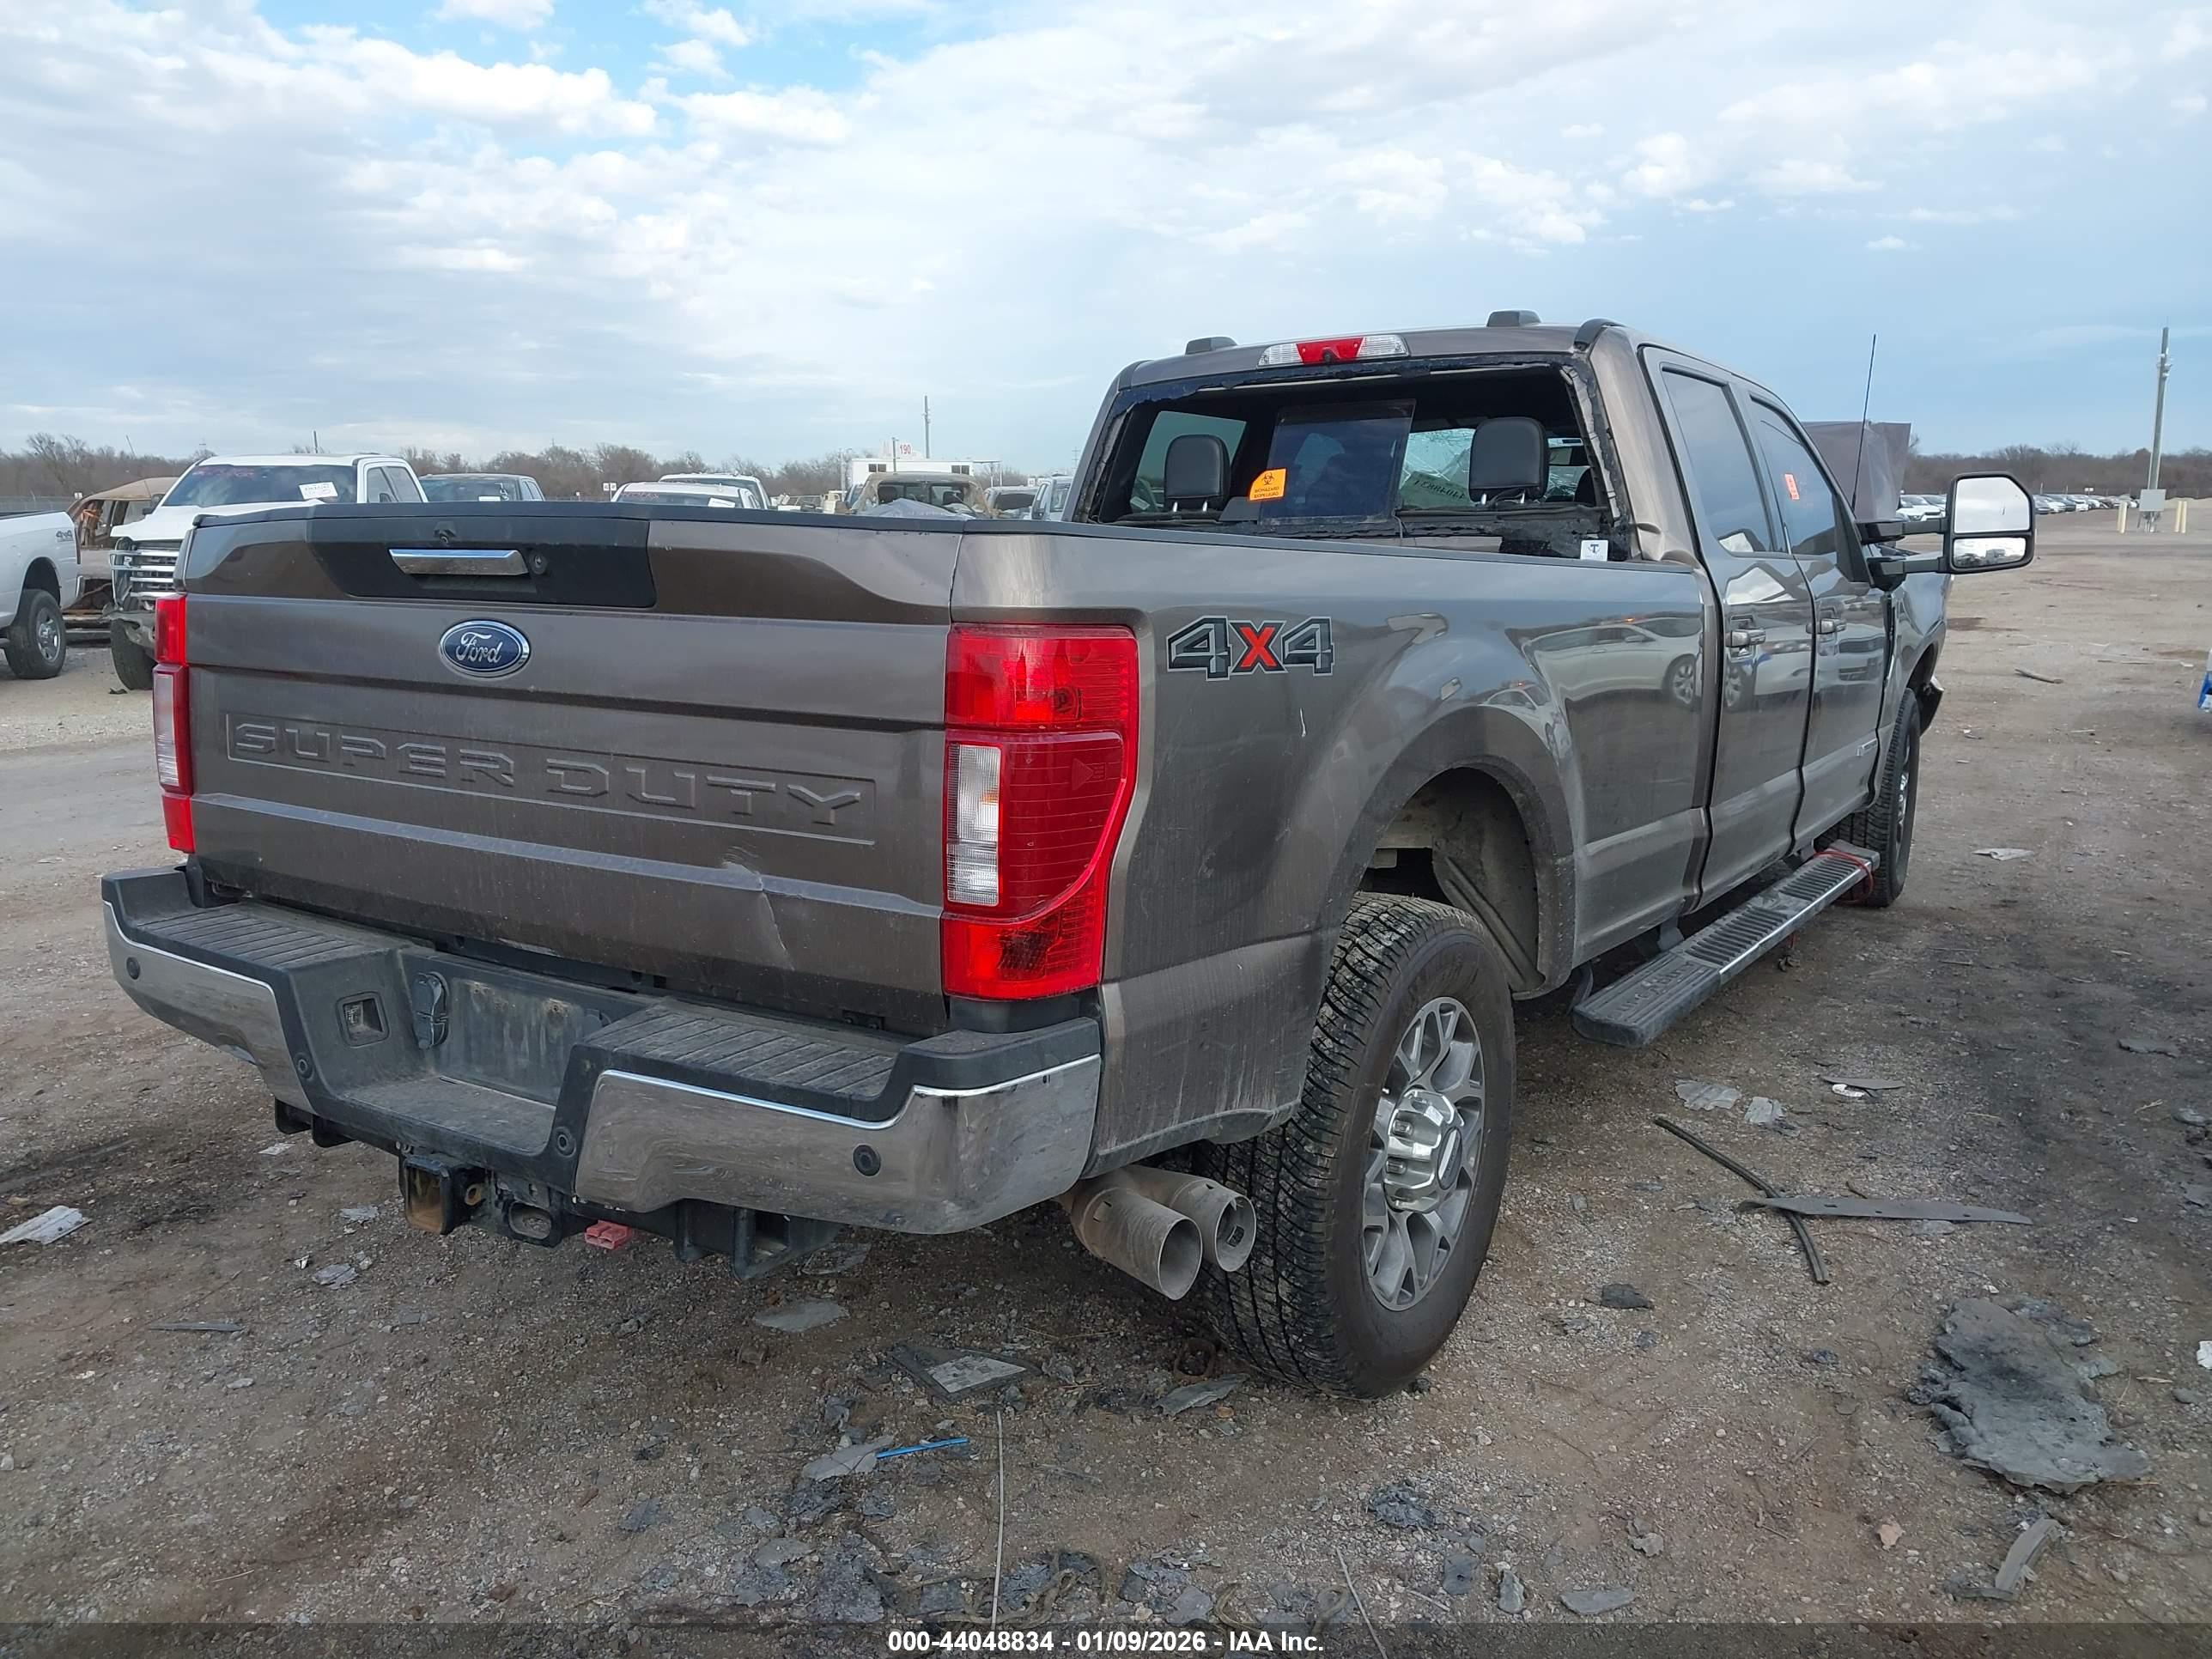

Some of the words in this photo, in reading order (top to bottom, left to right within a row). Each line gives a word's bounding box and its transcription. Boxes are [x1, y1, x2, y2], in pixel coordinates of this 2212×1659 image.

[900, 444, 911, 454] 190
[455, 631, 504, 663] Ford
[235, 722, 515, 787] SUPER
[546, 758, 861, 825] DUTY
